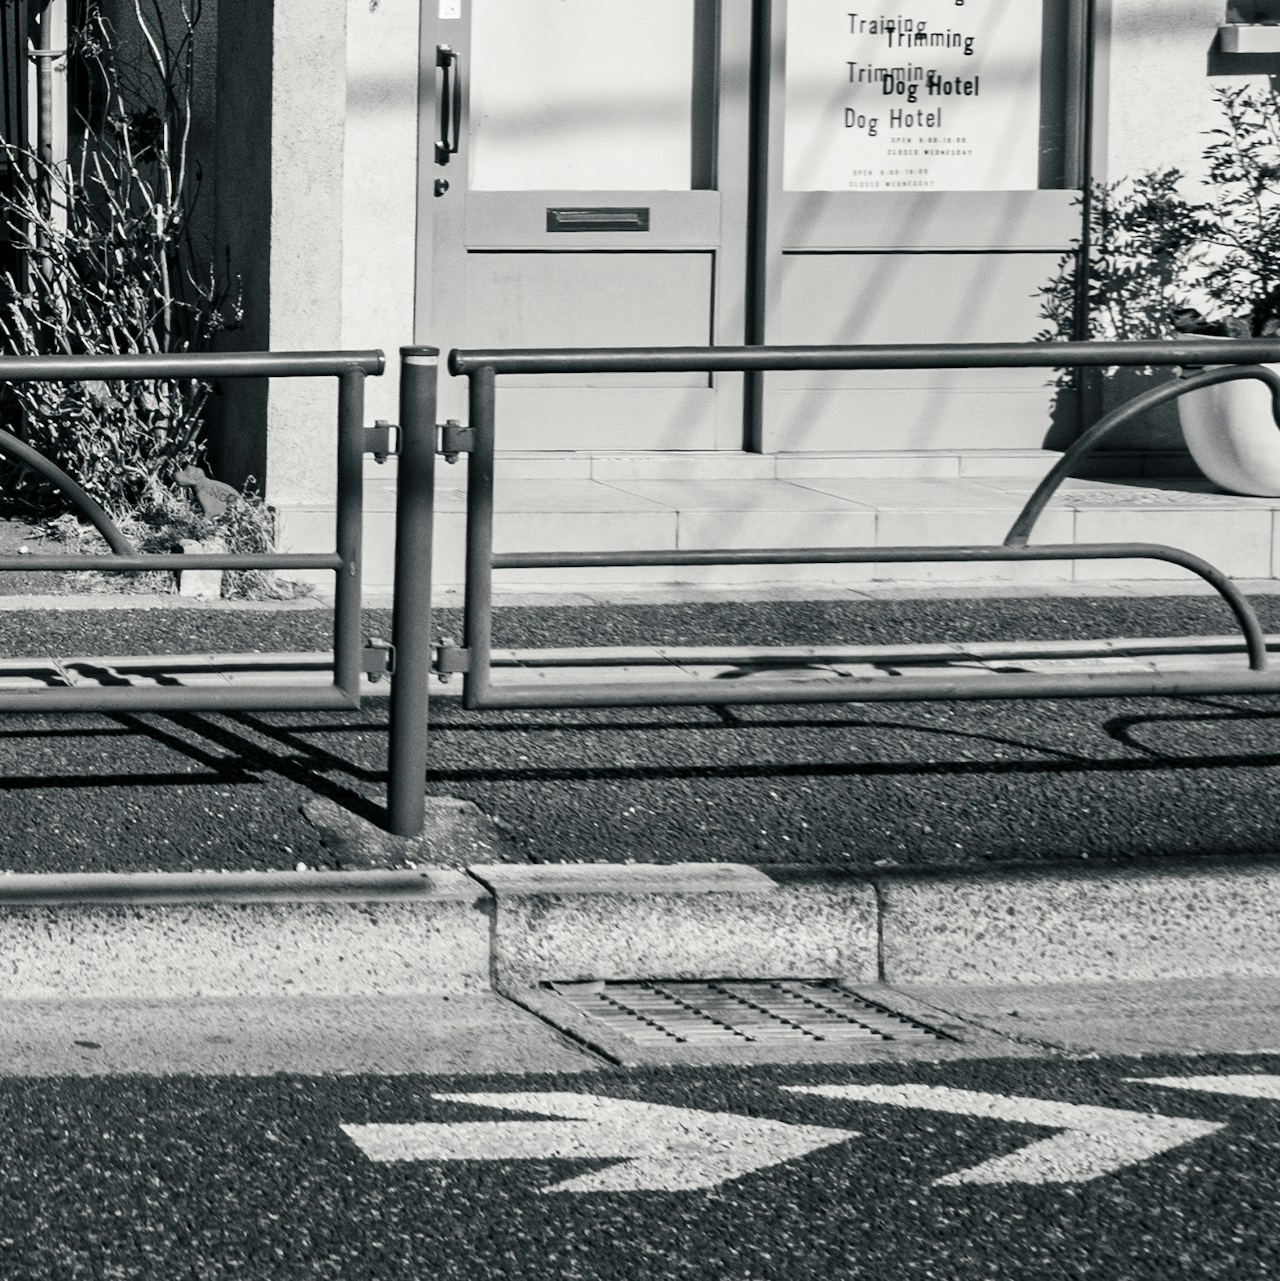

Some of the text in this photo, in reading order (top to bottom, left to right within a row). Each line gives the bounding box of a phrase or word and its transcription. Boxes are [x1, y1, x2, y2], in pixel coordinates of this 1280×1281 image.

[847, 13, 928, 39] Training
[885, 26, 975, 56] Trimming
[846, 61, 937, 88] Trimming
[882, 74, 980, 103] Dog Hotel
[844, 107, 942, 137] Dog Hotel
